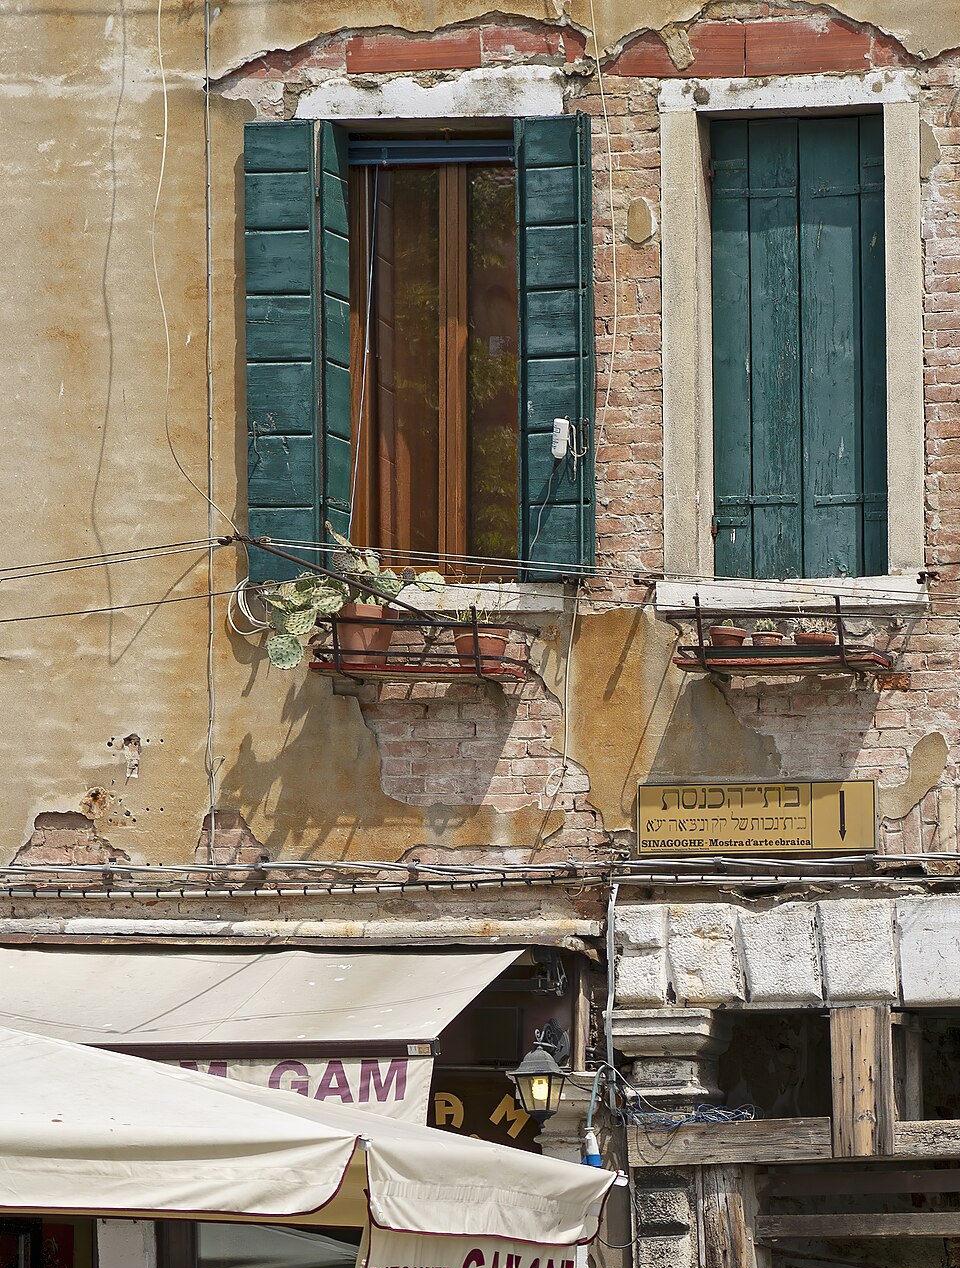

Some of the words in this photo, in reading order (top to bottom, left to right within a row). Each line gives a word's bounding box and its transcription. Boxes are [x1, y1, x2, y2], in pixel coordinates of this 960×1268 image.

[731, 811, 749, 831] של
[641, 839, 705, 848] SINAGOGHE
[708, 838, 744, 847] Mostra
[774, 837, 811, 846] ebraica
[268, 1059, 409, 1104] GAM
